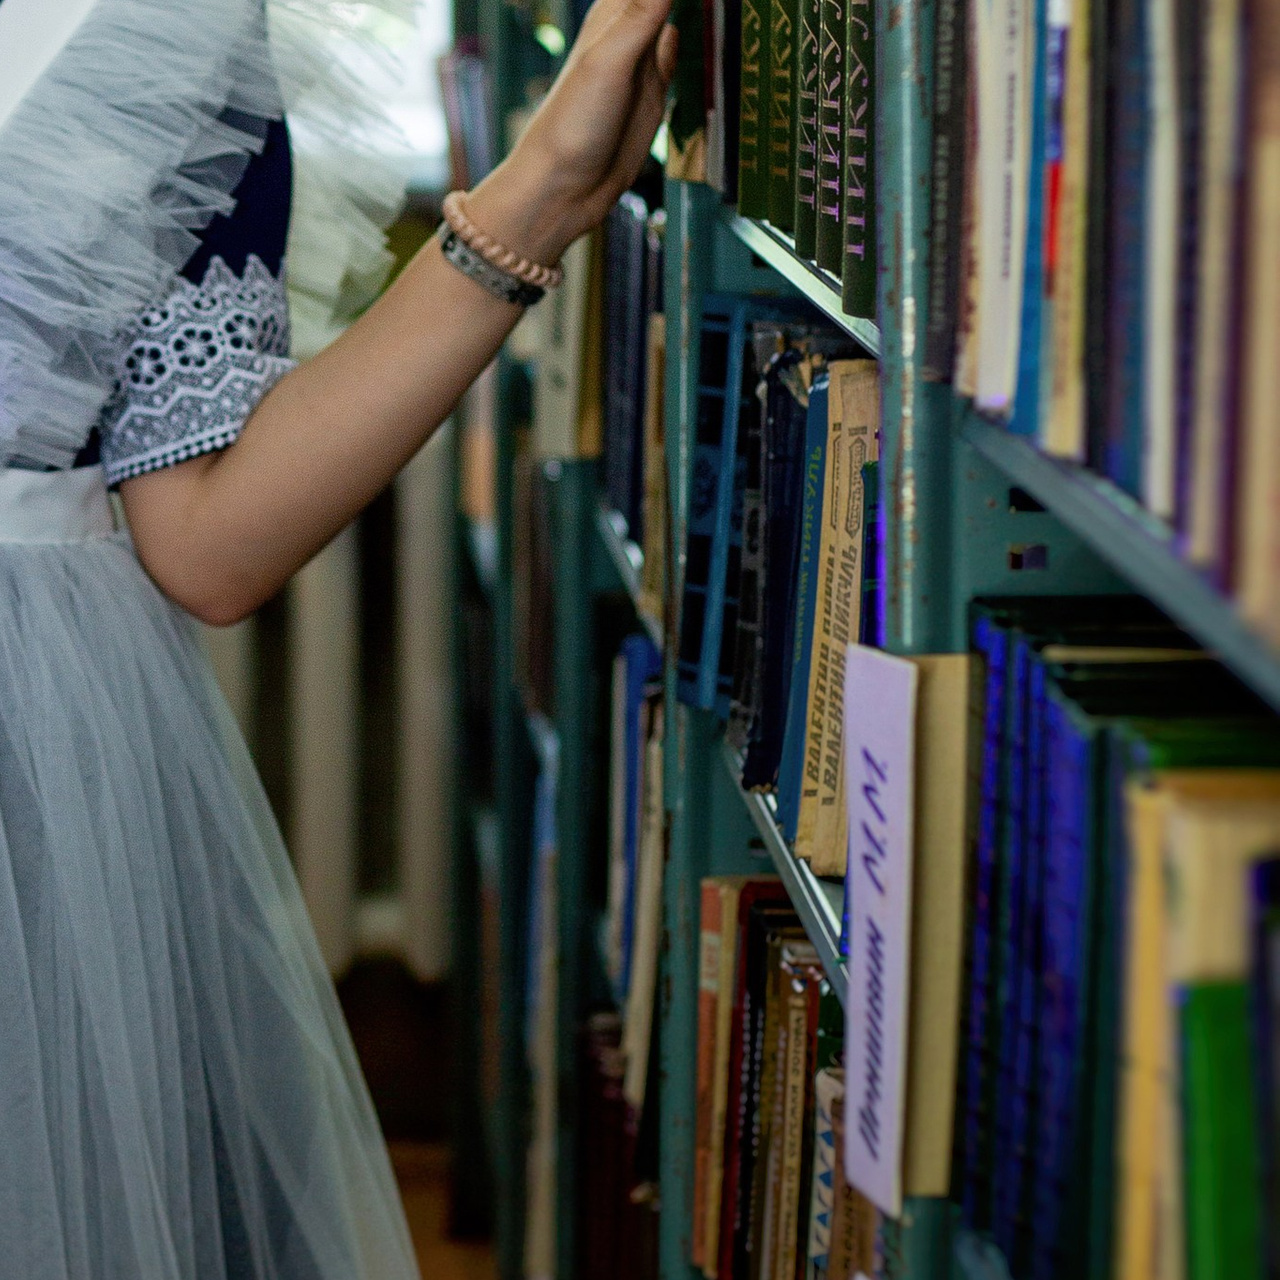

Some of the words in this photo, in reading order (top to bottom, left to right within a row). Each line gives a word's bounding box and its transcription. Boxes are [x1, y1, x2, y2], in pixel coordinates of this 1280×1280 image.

[800, 444, 823, 563] ПИКУЛЬ
[832, 544, 858, 644] ПИКУЛЬ
[822, 649, 848, 790] ВАЛЕНТИН
